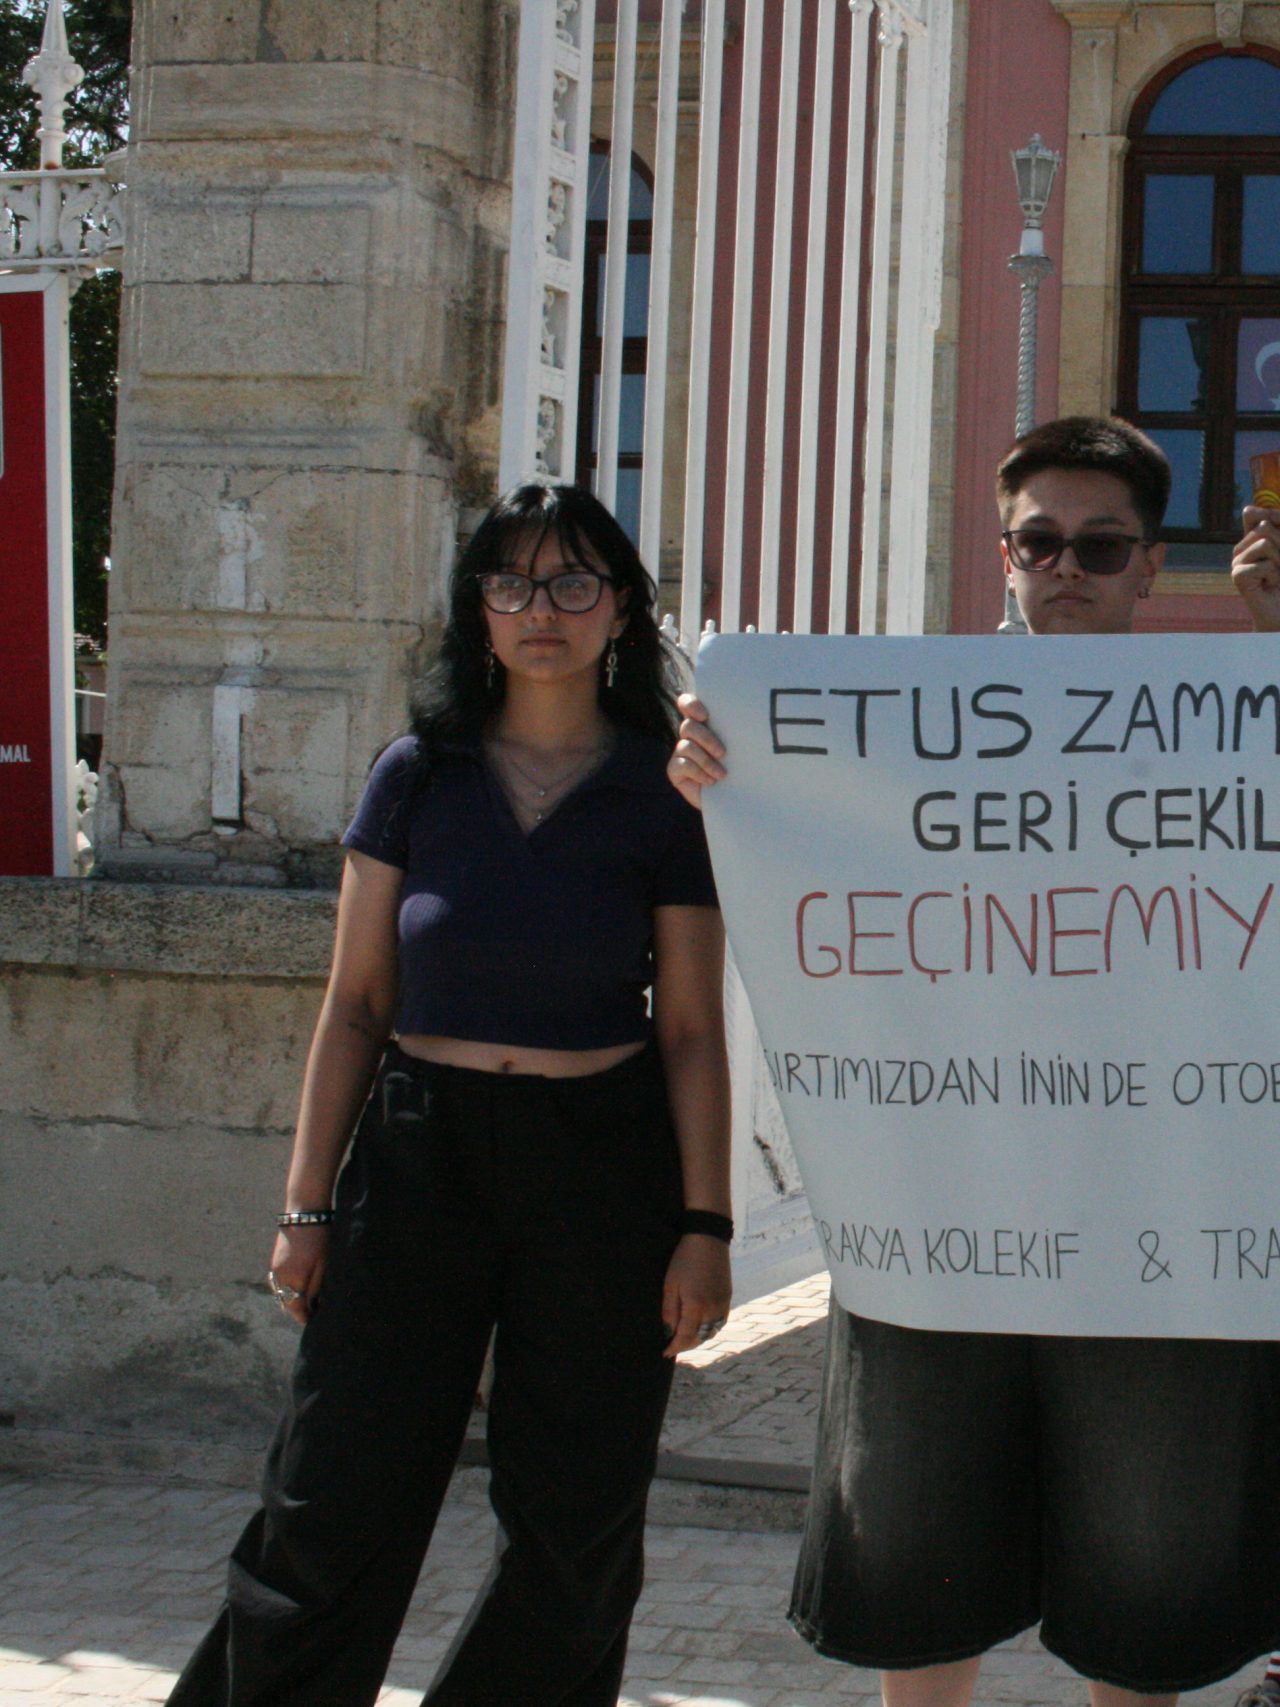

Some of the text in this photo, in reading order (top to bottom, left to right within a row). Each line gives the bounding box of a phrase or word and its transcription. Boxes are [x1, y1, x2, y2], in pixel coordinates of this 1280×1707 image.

[768, 683, 1033, 761] ETUS
[912, 780, 1078, 854] GERİ
[812, 1217, 911, 1276] RAKYA
[923, 1227, 1080, 1280] KOLEKİF
[1137, 1230, 1173, 1283] &
